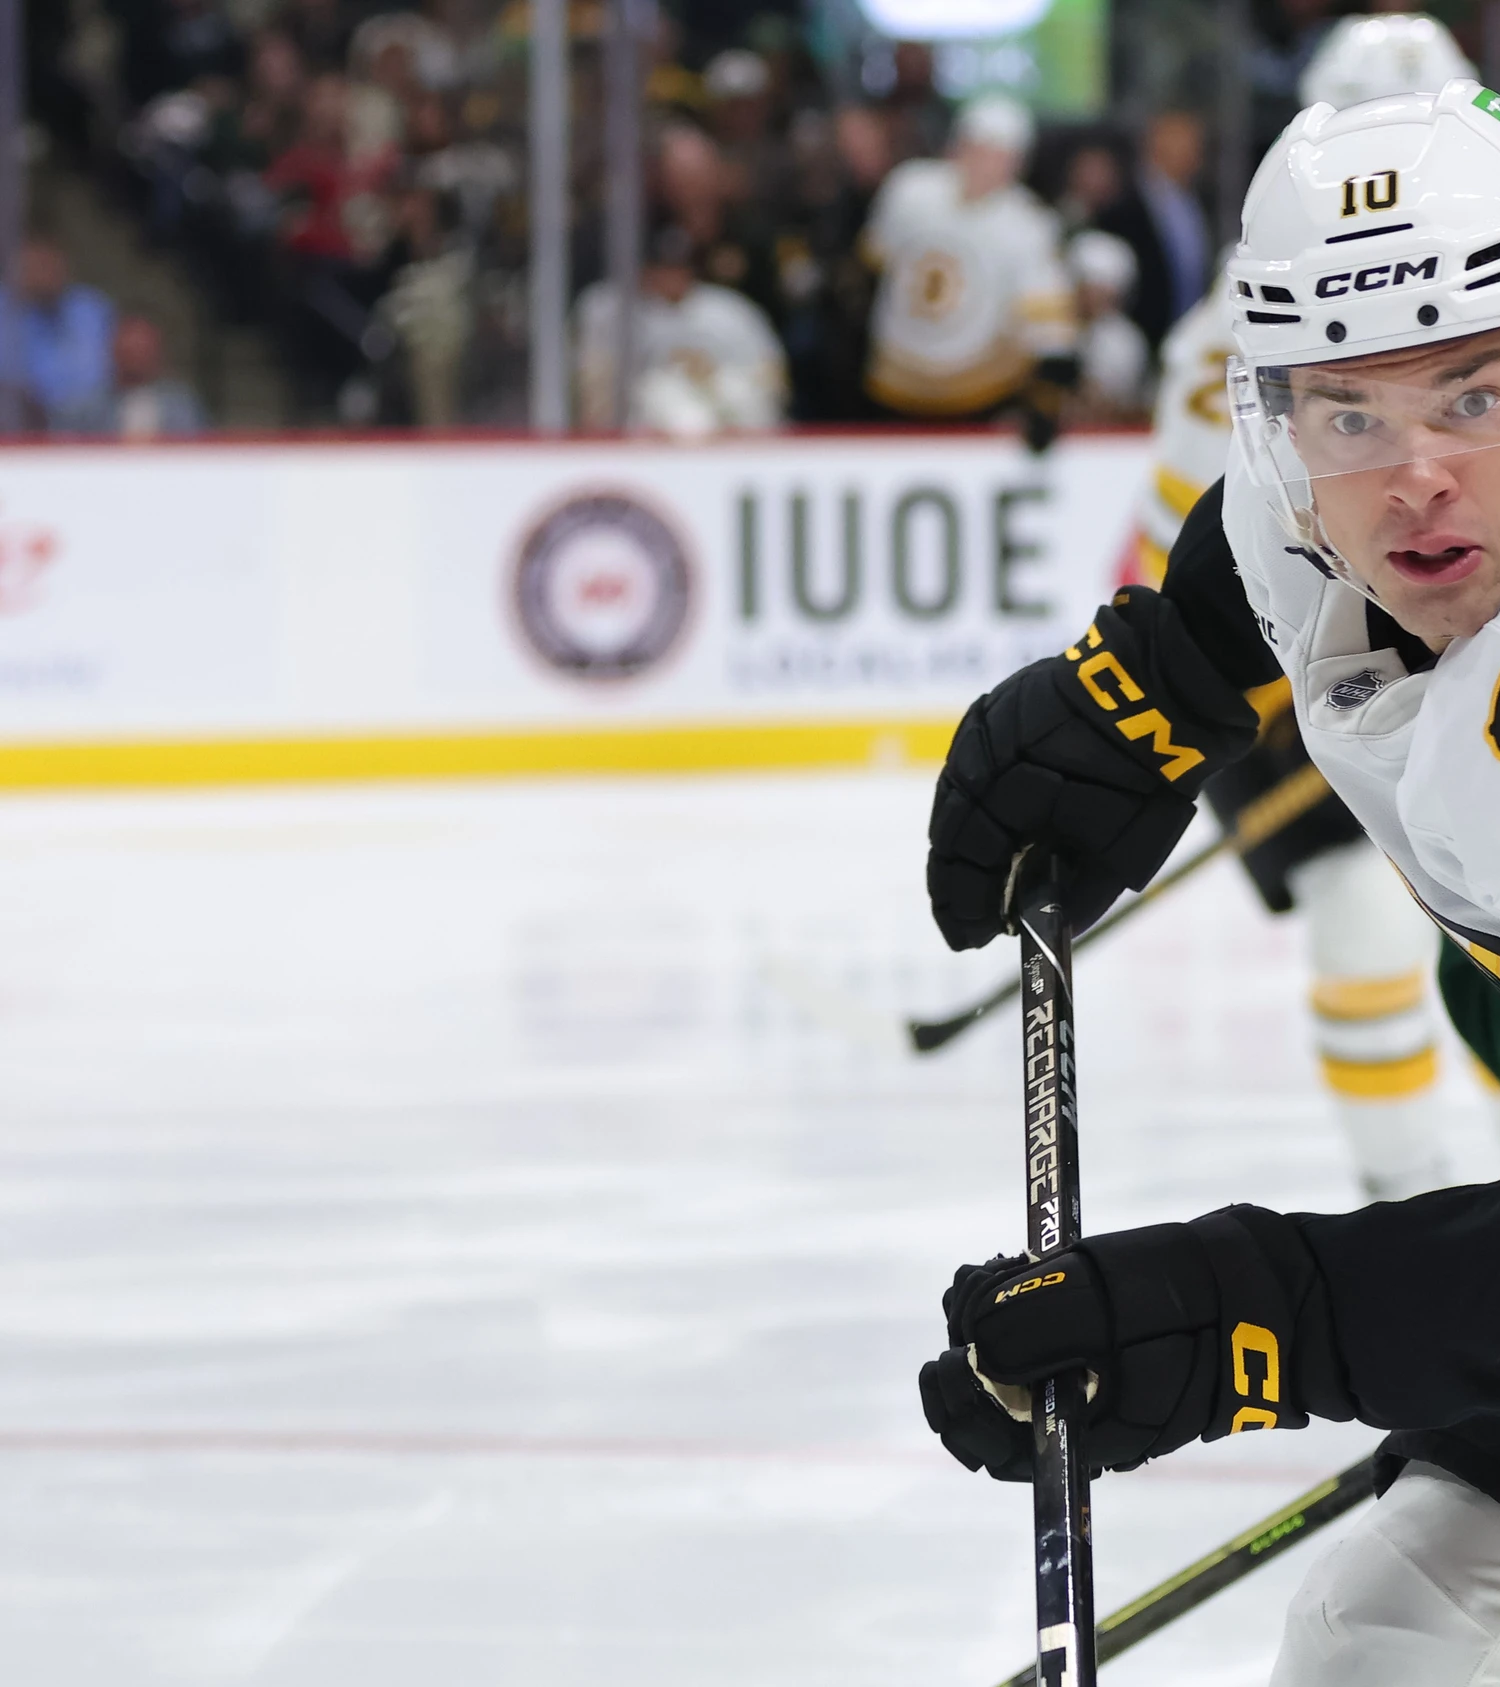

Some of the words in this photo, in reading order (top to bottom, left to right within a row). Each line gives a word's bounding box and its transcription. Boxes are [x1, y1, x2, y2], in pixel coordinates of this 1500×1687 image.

[1341, 170, 1399, 219] 10
[1315, 256, 1439, 299] CCM
[733, 482, 1052, 624] IUOE
[1026, 999, 1058, 1206] RECHARGE
[1040, 1196, 1060, 1252] PRO
[994, 1270, 1067, 1304] CCM
